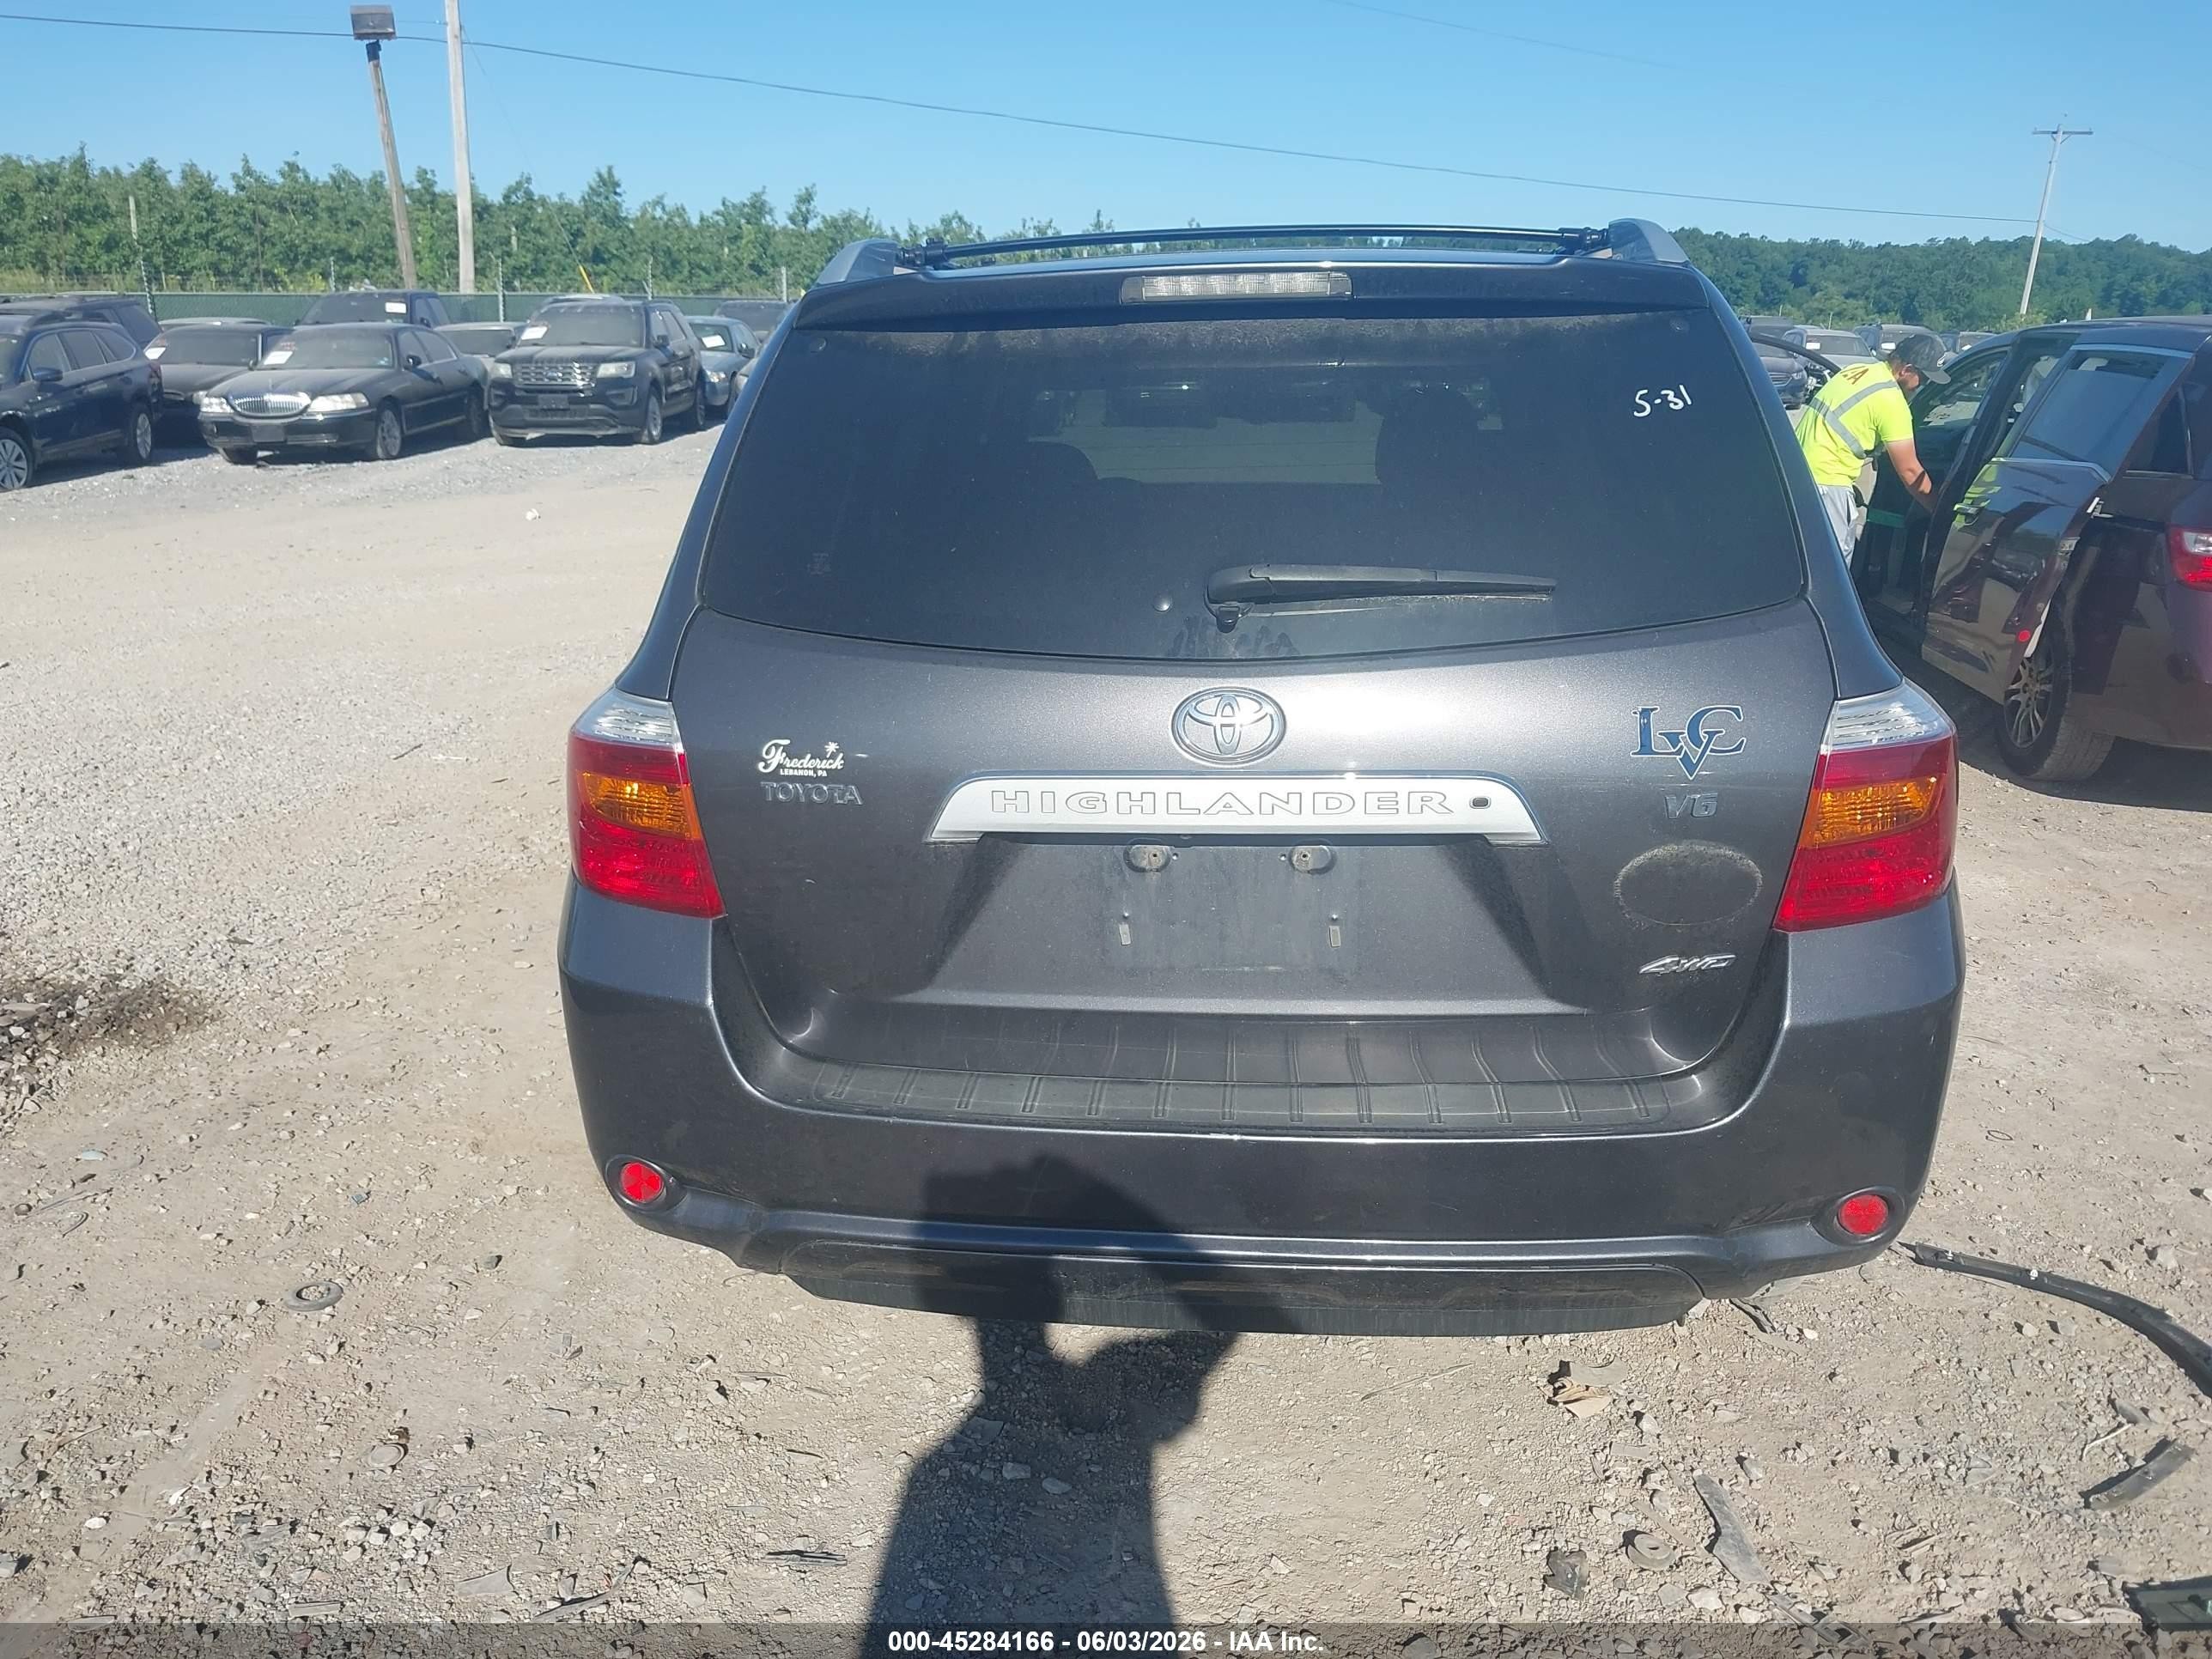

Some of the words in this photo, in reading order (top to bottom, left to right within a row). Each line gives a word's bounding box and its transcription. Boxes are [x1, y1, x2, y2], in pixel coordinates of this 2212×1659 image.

[757, 738, 845, 773] Frederick
[780, 769, 817, 778] LEBANON,
[760, 781, 864, 805] TOYOTA
[991, 790, 1454, 815] HIGHLANDER
[1664, 793, 1717, 819] V6
